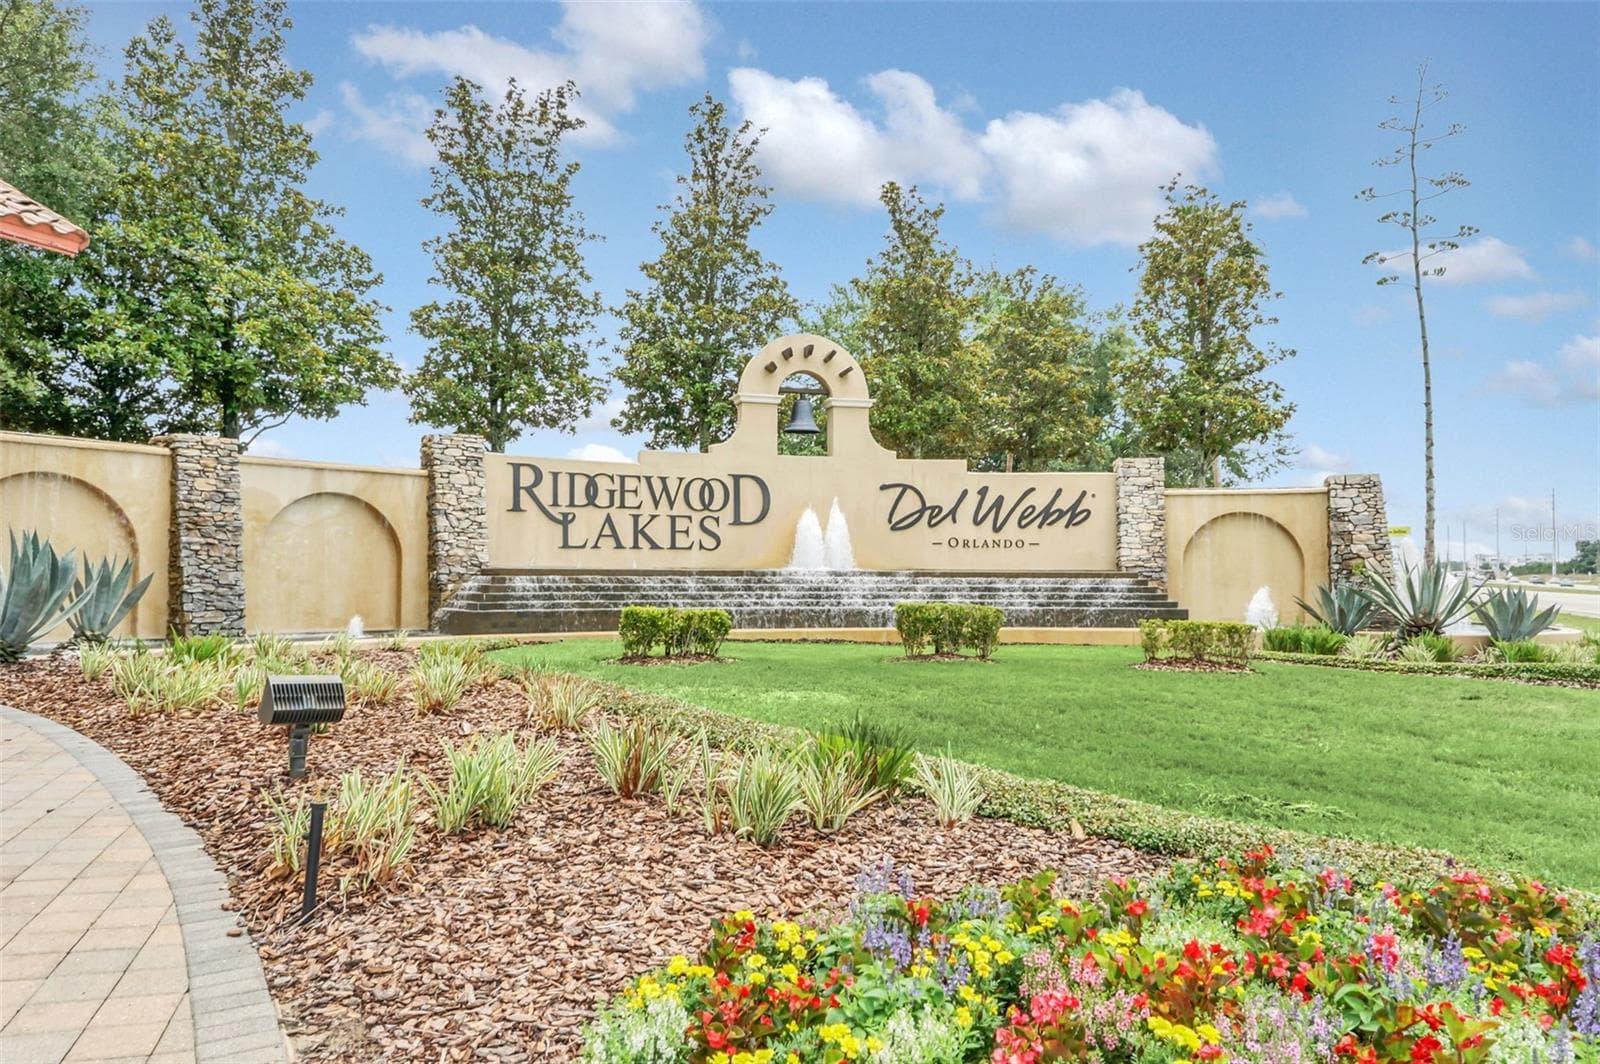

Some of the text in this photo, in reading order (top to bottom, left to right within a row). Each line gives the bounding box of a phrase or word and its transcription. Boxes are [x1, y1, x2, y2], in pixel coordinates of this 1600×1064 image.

[507, 462, 771, 525] RIDGEWOOD
[880, 483, 1093, 533] Del Webb
[558, 512, 721, 551] LAKES
[948, 537, 1025, 549] ORLANDO
